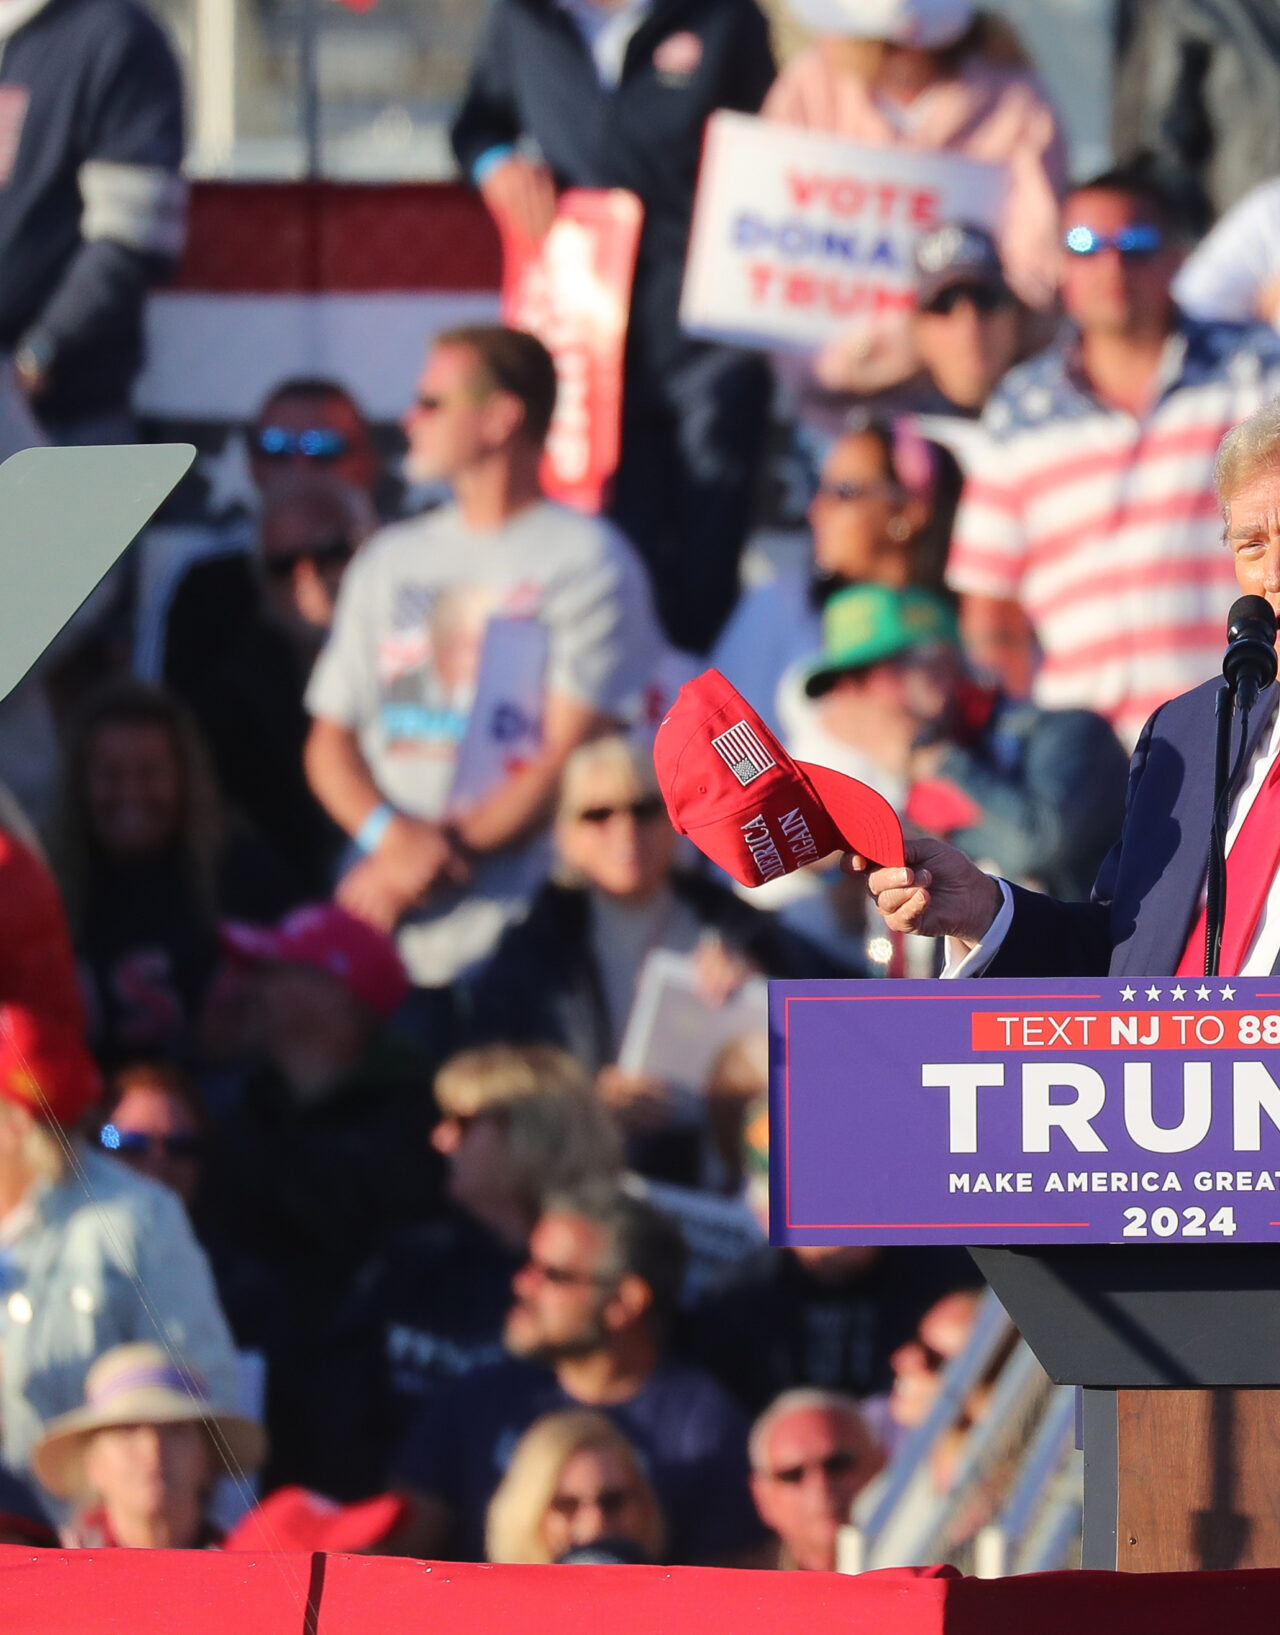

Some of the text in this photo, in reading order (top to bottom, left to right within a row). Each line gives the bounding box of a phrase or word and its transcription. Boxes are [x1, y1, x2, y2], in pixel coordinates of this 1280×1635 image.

[786, 168, 939, 231] VOTE
[735, 213, 900, 267] DONA
[747, 262, 917, 320] TRUM
[740, 813, 786, 882] MERICA
[777, 807, 818, 860] AGAIN
[996, 1016, 1097, 1046] TEXT
[1110, 1015, 1160, 1046] NJ
[1172, 1015, 1225, 1045] TO
[949, 1172, 1033, 1193] MAKE
[1044, 1171, 1183, 1193] AMERICA
[1122, 1206, 1237, 1237] 2024
